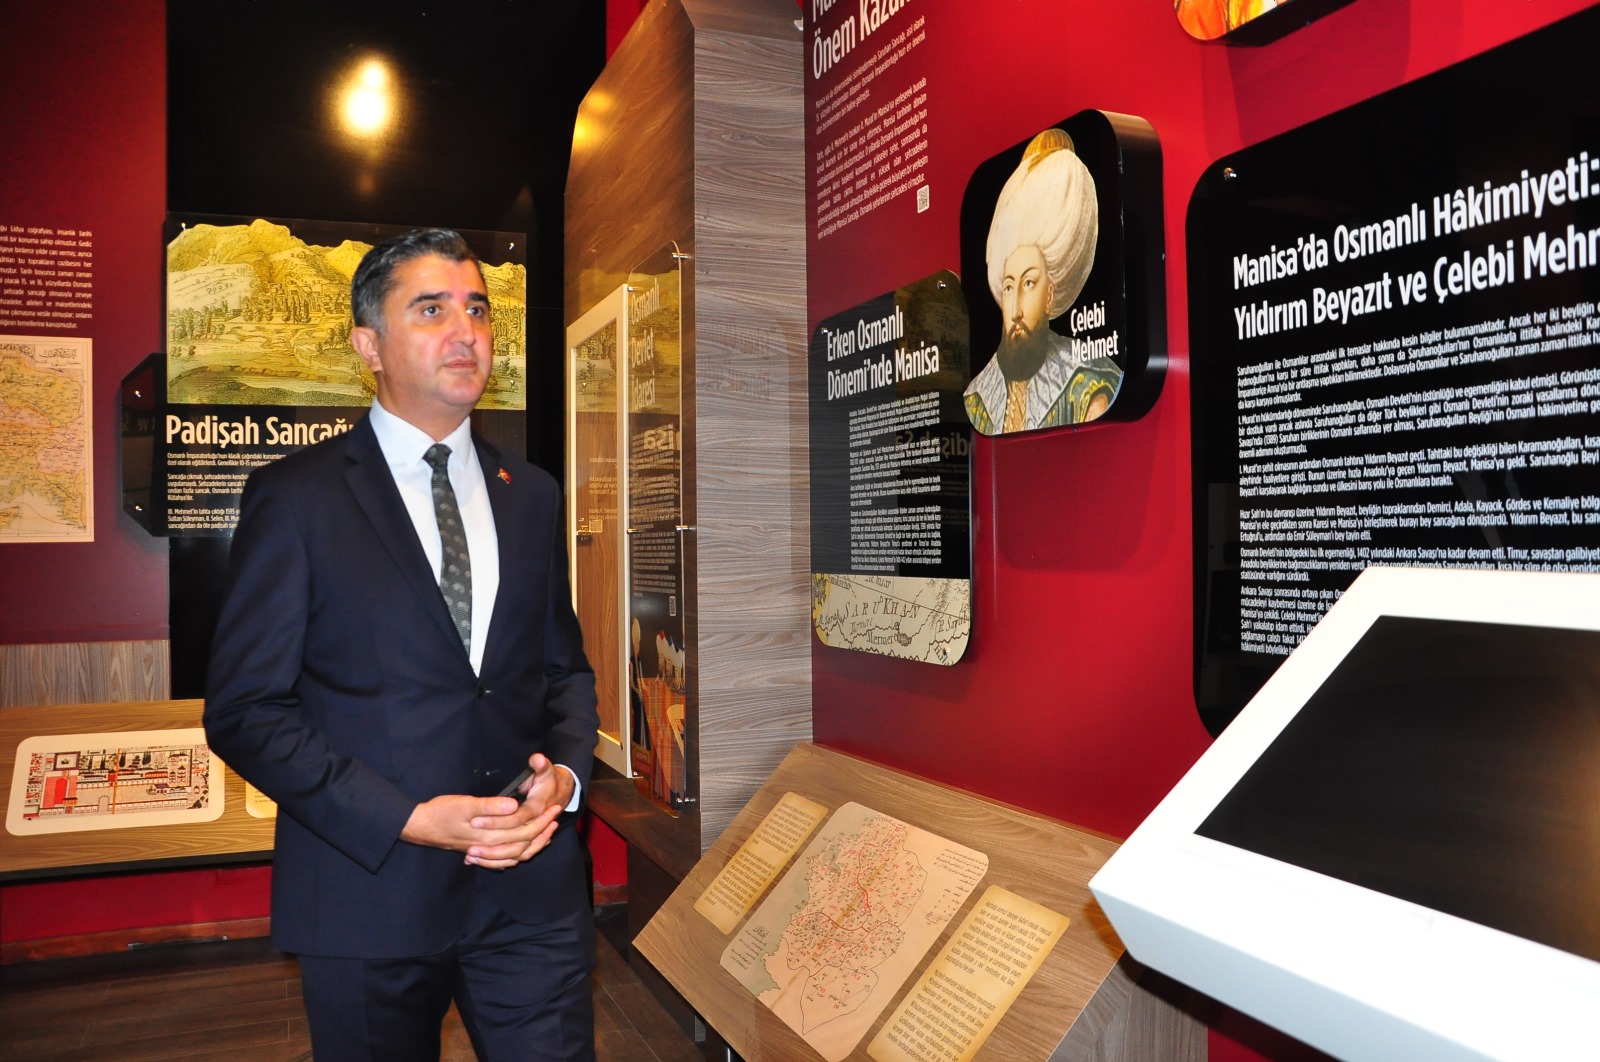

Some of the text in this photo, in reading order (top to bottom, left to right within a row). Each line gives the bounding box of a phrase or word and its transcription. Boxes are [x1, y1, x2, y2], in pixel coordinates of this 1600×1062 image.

[813, 15, 856, 80] Önem
[860, 0, 911, 42] Kaza
[1235, 151, 1600, 290] Manisa'da Osmanlı Hâkimiyeti:
[632, 277, 660, 325] Osmanlı
[1236, 299, 1307, 340] Yıldırım
[1313, 272, 1392, 324] Beyazıt
[1398, 271, 1427, 305] ve
[1434, 240, 1514, 303] Çelebi
[827, 305, 904, 362] Erken Osmanlı
[1070, 303, 1106, 337] Çelebi
[1373, 302, 1595, 352] hakkında kesin bilgiler bulunmamaktadır. Ancak her iki beyliğin
[632, 327, 654, 368] Devlet
[1071, 331, 1119, 363] Mehmet
[1384, 332, 1591, 376] Dolayısıyla Osmanlılar ve Saruhanoğulları zaman zaman ittifak
[1397, 318, 1582, 361] da Saruhanoğulları'nın Osmanlılarla ittifak halindeki
[827, 344, 940, 401] Dönemi'nde Manisa
[632, 370, 656, 412] İdaresi
[1366, 396, 1389, 409] Osmanlı
[1390, 392, 1422, 406] Devleti'nin
[1422, 388, 1454, 402] üstünlüğü
[1455, 388, 1463, 398] ve
[1464, 379, 1509, 397] egemenliğini
[1510, 376, 1530, 391] kabul
[1531, 373, 1559, 389] etmişti.
[1384, 387, 1578, 419] Türk beylikleri gibi Osmanlı Devleti'nin zoraki vasallarına
[166, 414, 260, 448] Padişah
[1383, 400, 1588, 434] yer alması, Saruhanoğulları Beyliği'nin Osmanlı hâkimiyetine
[1363, 451, 1579, 477] Anadolu'ya geçen Yıldırım Beyazıt, Manisa'ya geldi. Saruhanoğlu
[1365, 436, 1583, 464] Yıldırım Beyazıt geçti. Tahttaki bu değişikliği bilen Karamanoğulları,
[1395, 474, 1453, 488] Osmanlılara bıraktı.
[1399, 510, 1583, 528] burayı bey sancağına dönüştürdü. Yıldırım Beyazıt, bu
[1427, 496, 1579, 513] Demirci, Adala, Kayacık, Gördes ve Kemaliye
[1396, 547, 1417, 558] Ankara
[1418, 547, 1447, 558] Savaşı'na
[1448, 547, 1466, 559] kadar
[1467, 547, 1491, 559] devam
[1492, 547, 1506, 559] etti.
[1507, 547, 1530, 559] Timur,
[1531, 548, 1564, 559] savaştan
